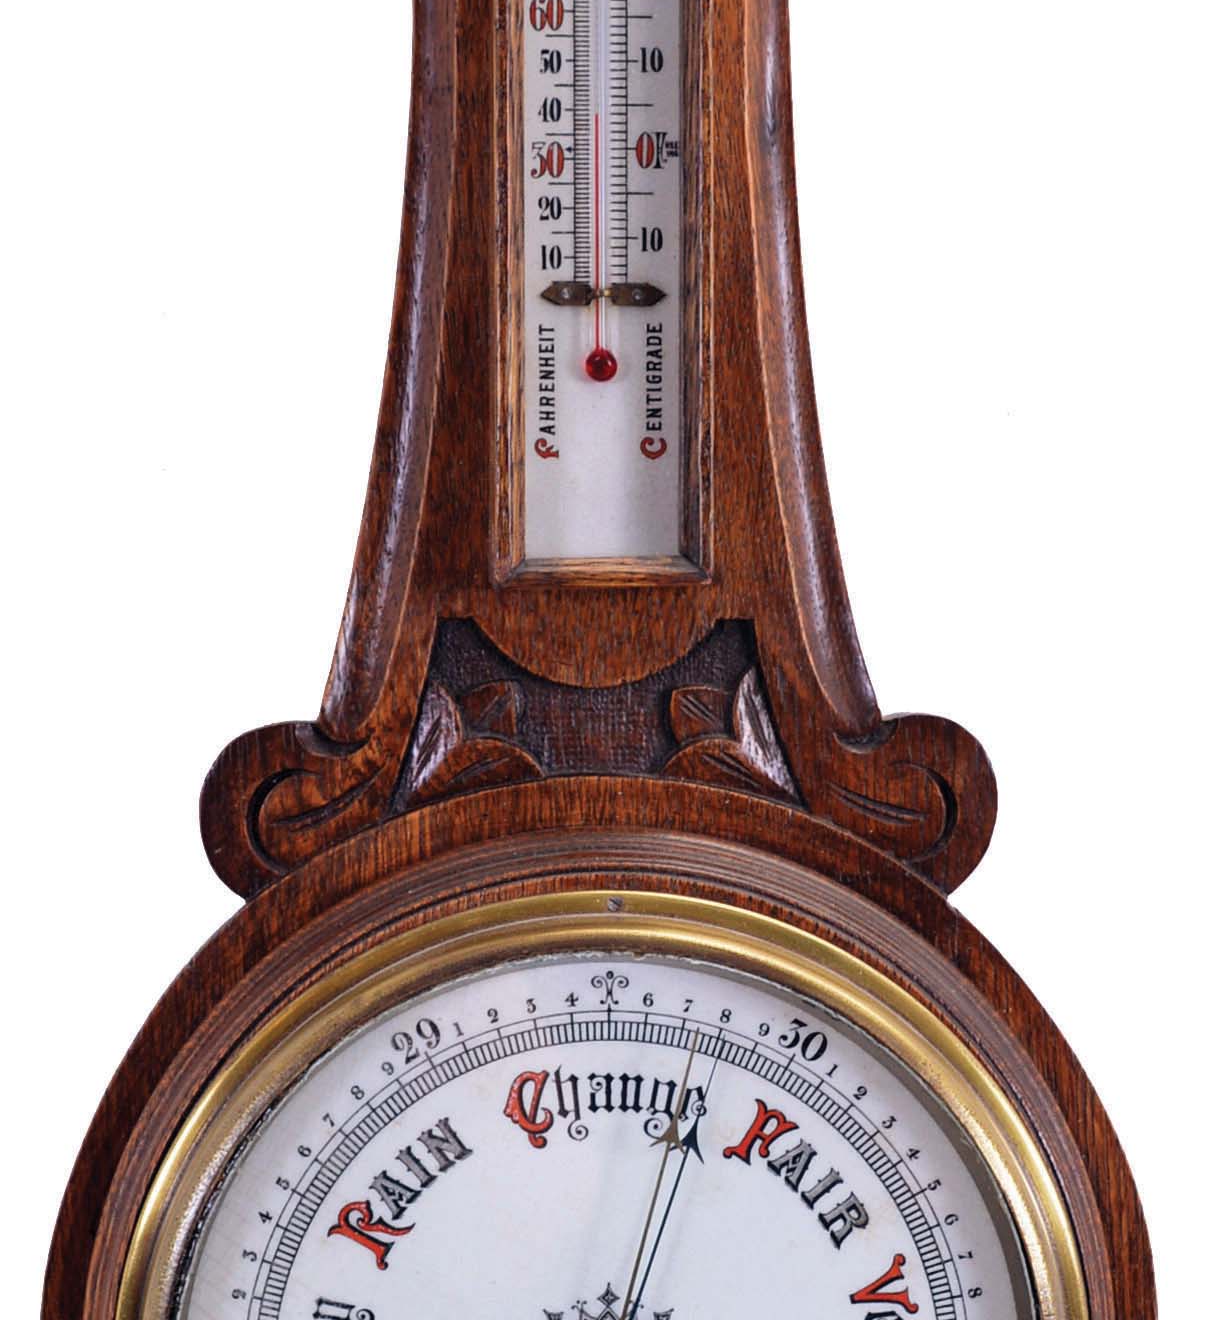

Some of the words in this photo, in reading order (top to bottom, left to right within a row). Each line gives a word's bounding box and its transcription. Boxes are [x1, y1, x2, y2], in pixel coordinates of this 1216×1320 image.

[539, 48, 562, 74] 50
[640, 47, 664, 73] 10
[537, 97, 562, 123] 40
[531, 141, 564, 179] 30
[537, 196, 563, 221] 20
[641, 226, 664, 253] 10
[541, 244, 562, 271] 10
[534, 323, 560, 459] FAHRENHEIT
[639, 322, 668, 460] CENTIGRADE
[526, 997, 537, 1014] 3
[564, 991, 579, 1008] 4
[642, 992, 654, 1008] 6
[683, 998, 694, 1013] 7
[486, 1007, 499, 1024] 2
[719, 1008, 733, 1024] 8
[452, 1021, 465, 1038] 1
[758, 1022, 771, 1037] 9
[391, 1018, 441, 1064] 29
[778, 1018, 828, 1062] 30
[380, 1061, 395, 1076] 9
[825, 1063, 839, 1078] 1
[350, 1084, 365, 1101] 8
[852, 1085, 868, 1101] 2
[503, 1064, 707, 1149] Change
[322, 1112, 336, 1128] 7
[881, 1115, 897, 1130] 3
[297, 1144, 312, 1158] 6
[906, 1148, 921, 1161] 4
[723, 1098, 870, 1249] FAIR
[275, 1176, 290, 1191] 5
[927, 1178, 942, 1192] 5
[327, 1117, 474, 1270] RAIN
[258, 1211, 273, 1224] 4
[944, 1213, 960, 1226] 6
[241, 1249, 258, 1263] 3
[957, 1250, 974, 1260] 7
[231, 1288, 247, 1300] 2
[967, 1286, 983, 1299] 8
